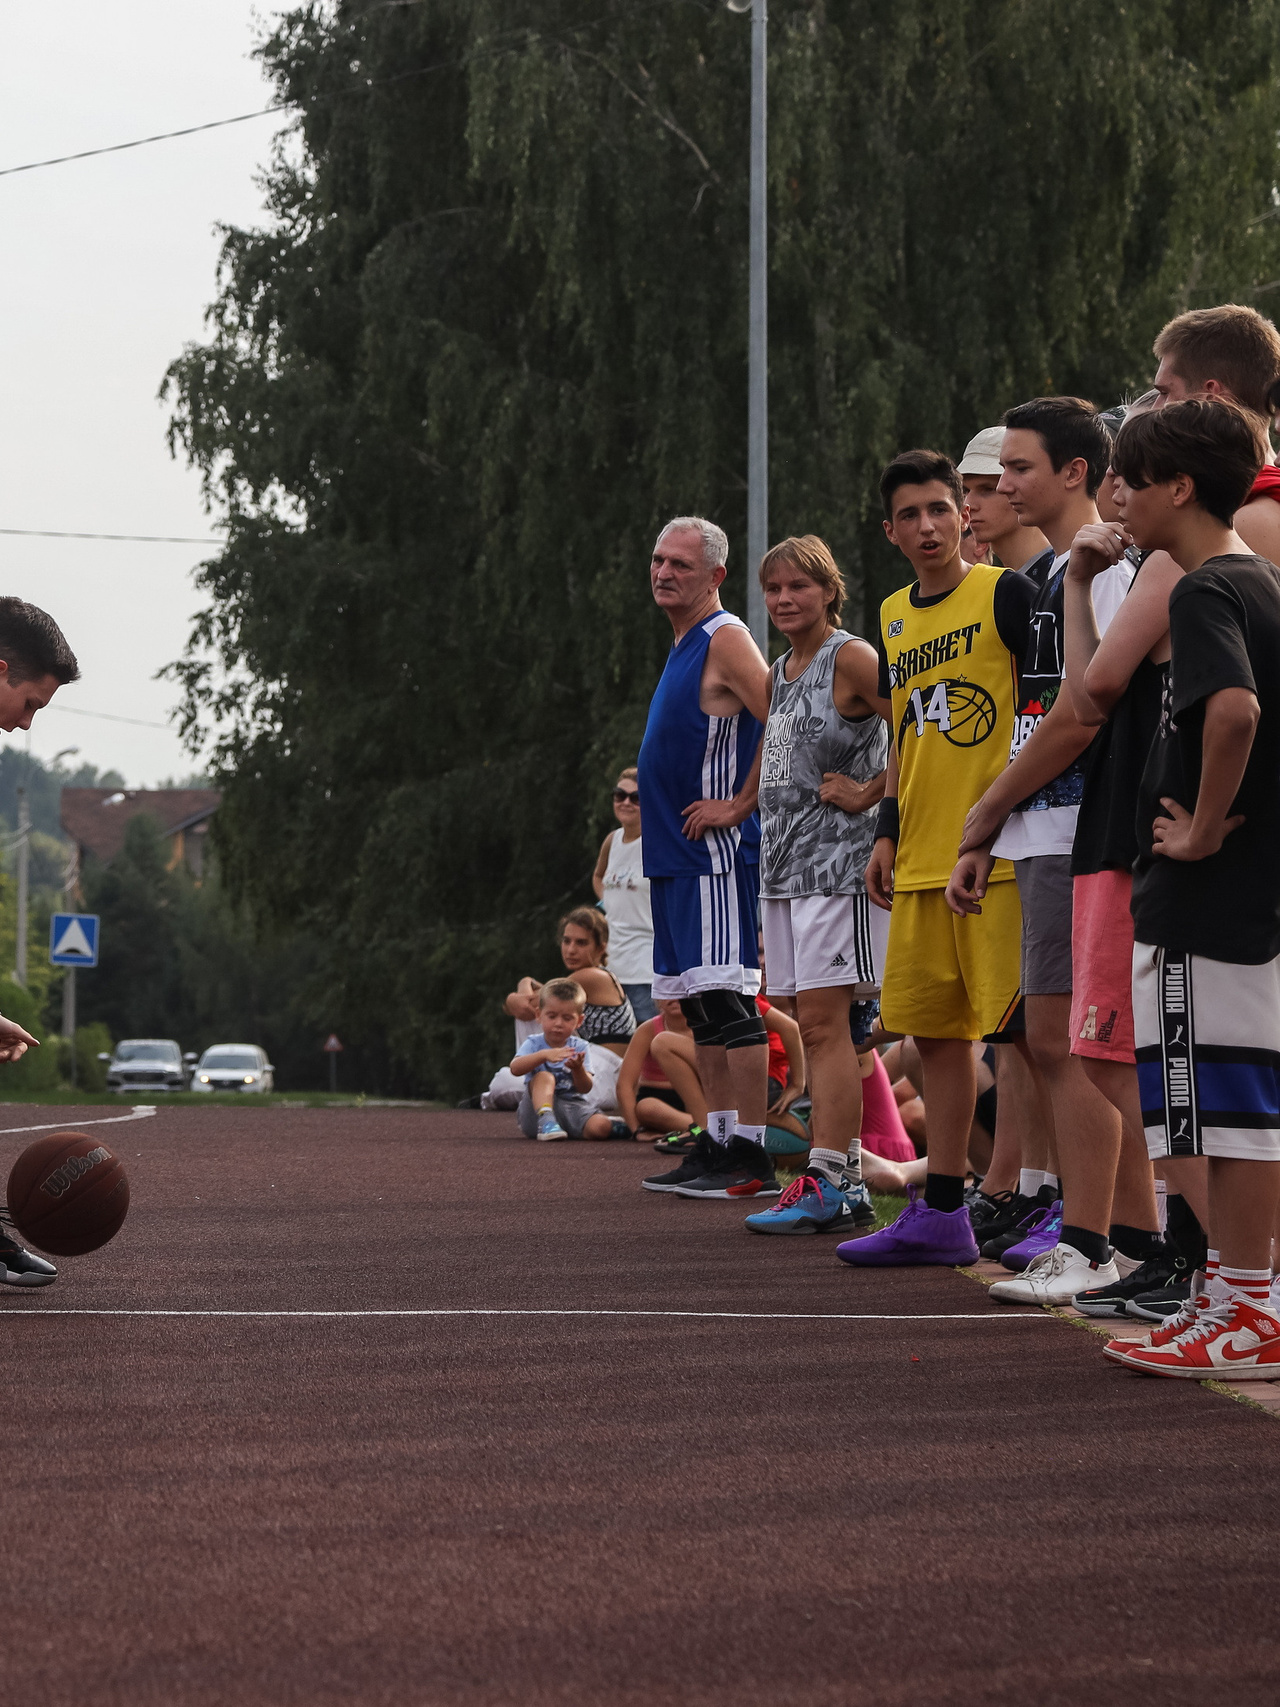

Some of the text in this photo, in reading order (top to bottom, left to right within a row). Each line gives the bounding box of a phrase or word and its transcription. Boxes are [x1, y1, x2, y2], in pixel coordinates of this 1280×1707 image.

[897, 622, 981, 692] BASKET
[910, 687, 951, 737] 14
[1165, 963, 1185, 1013] PUMA
[1079, 1005, 1098, 1040] A
[1169, 1057, 1189, 1107] PUMA
[39, 1146, 112, 1198] Wilson
